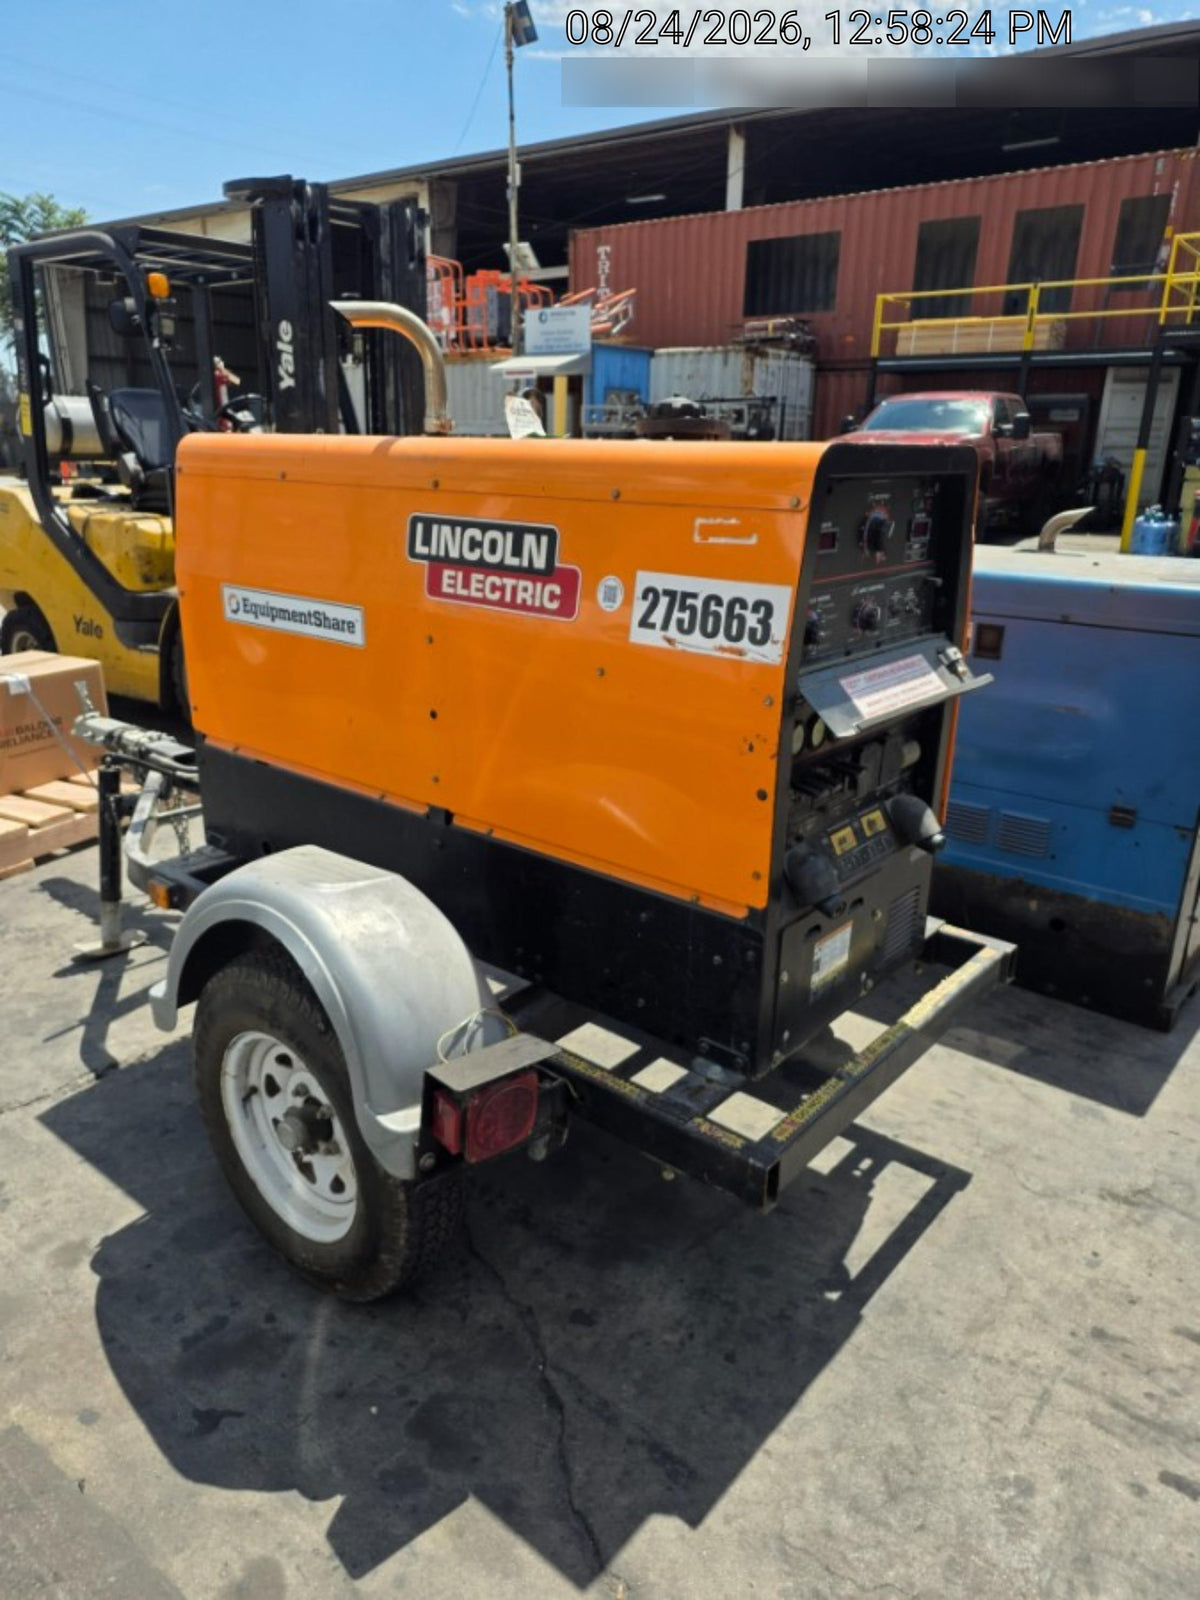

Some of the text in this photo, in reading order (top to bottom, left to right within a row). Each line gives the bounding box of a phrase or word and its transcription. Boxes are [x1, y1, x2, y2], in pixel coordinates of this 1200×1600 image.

[277, 319, 296, 391] Yale
[415, 521, 549, 571] LINCOLN
[441, 569, 562, 610] ELECTRIC
[73, 615, 104, 639] Yale
[242, 597, 357, 635] EquipmentShare
[637, 585, 774, 647] 275663
